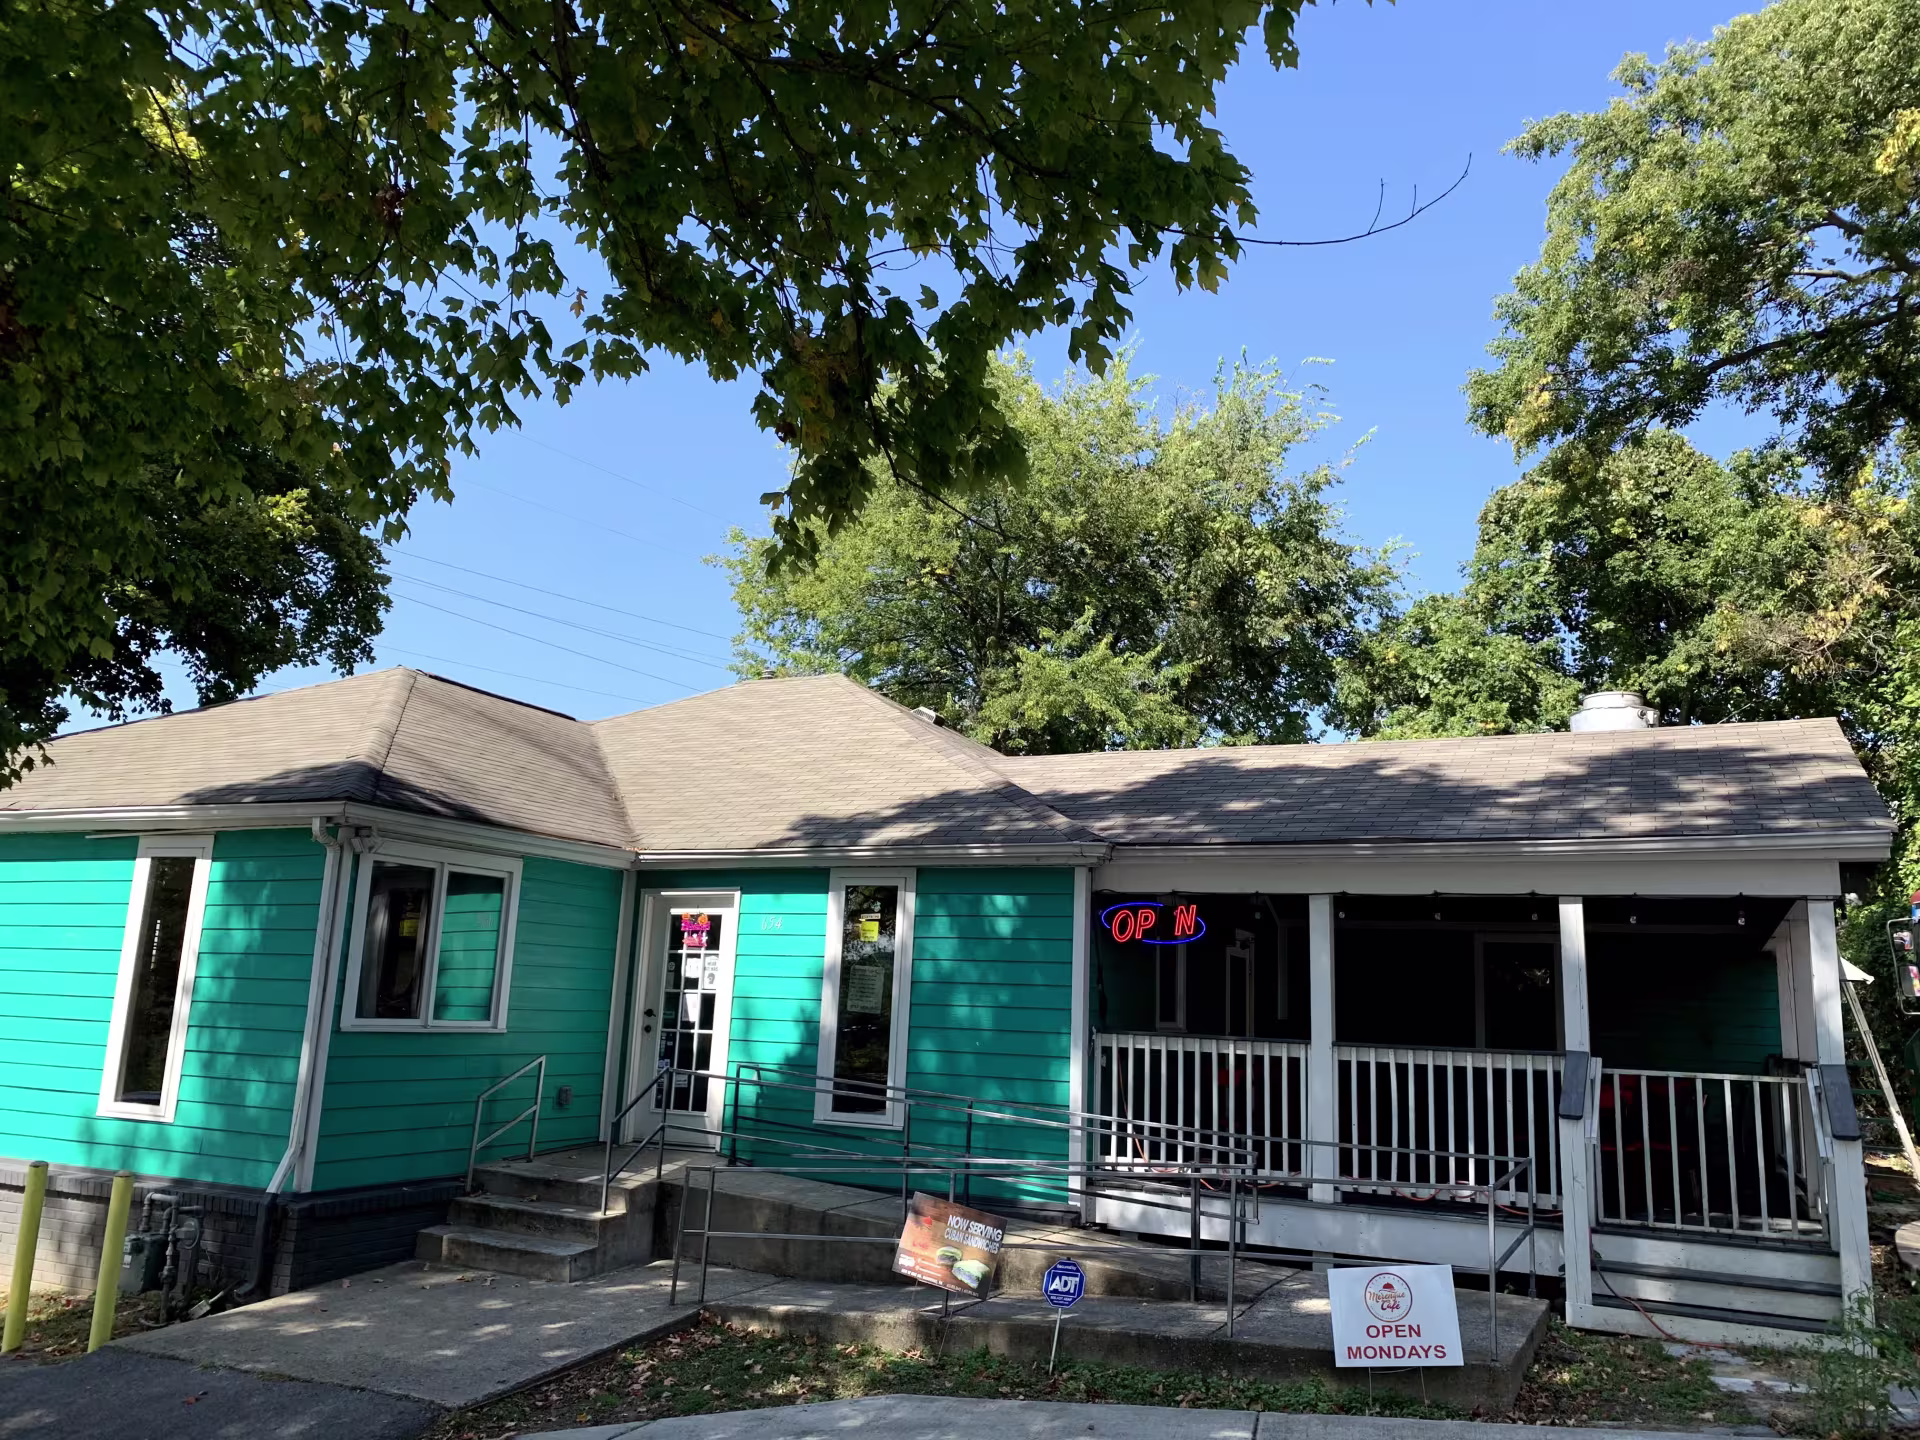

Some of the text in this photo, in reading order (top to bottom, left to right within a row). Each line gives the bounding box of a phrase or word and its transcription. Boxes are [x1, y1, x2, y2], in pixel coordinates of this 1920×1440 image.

[1111, 904, 1197, 943] OPN
[947, 1215, 1002, 1241] NOW SERVING
[944, 1228, 1000, 1253] CUBAN SANDWICHES
[1049, 1275, 1080, 1294] ADT
[1366, 1324, 1421, 1338] OPEN
[1347, 1345, 1447, 1360] MONDAYS
